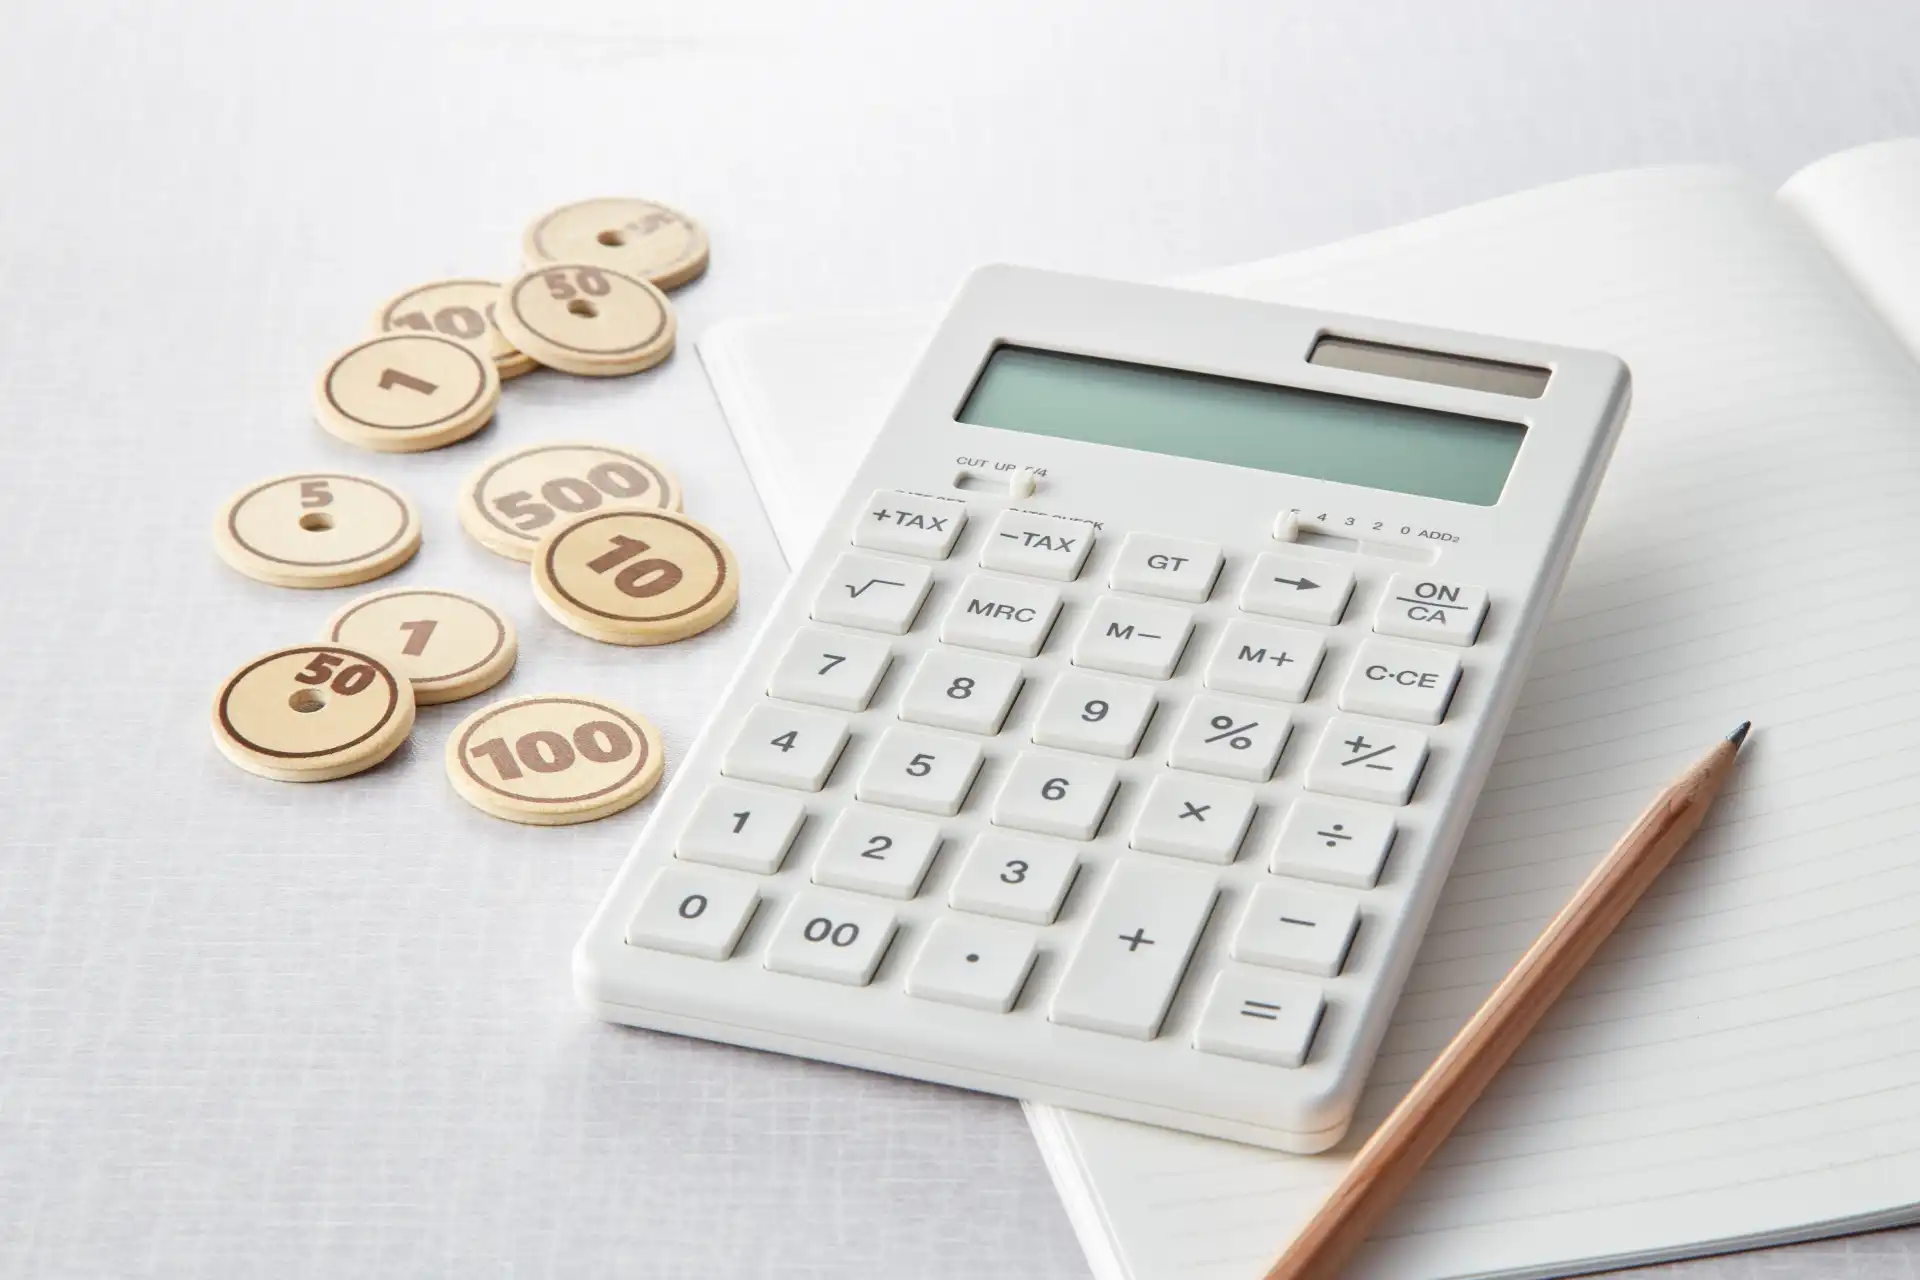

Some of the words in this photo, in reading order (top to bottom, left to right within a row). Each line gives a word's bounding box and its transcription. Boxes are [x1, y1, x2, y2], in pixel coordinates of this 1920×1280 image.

[545, 267, 611, 300] 50
[392, 302, 498, 339] 10
[378, 367, 440, 396] 1
[956, 457, 989, 468] CUT
[994, 462, 1016, 472] UP
[1025, 466, 1048, 478] /4
[301, 481, 333, 508] 5
[492, 462, 650, 530] 500
[873, 510, 948, 532] +TAX
[1317, 513, 1327, 522] 4
[1344, 517, 1356, 526] 3
[1372, 521, 1384, 531] 2
[1400, 526, 1411, 535] 0
[586, 534, 683, 598] 10
[1147, 554, 1189, 572] GT
[1415, 582, 1460, 602] ON
[966, 598, 1037, 623] MRC
[1407, 606, 1447, 624] CA
[400, 620, 438, 656] 1
[818, 653, 846, 676] 7
[1238, 645, 1294, 667] M+
[294, 652, 376, 696] 50
[946, 677, 975, 700] 8
[1081, 700, 1109, 722] 9
[470, 720, 633, 781] 100
[770, 731, 798, 752] 4
[905, 753, 935, 776] 5
[1041, 777, 1069, 800] 6
[733, 811, 751, 833] 1
[861, 836, 892, 860] 2
[1000, 860, 1029, 884] 3
[678, 894, 707, 919] 0
[804, 917, 860, 947] 00
